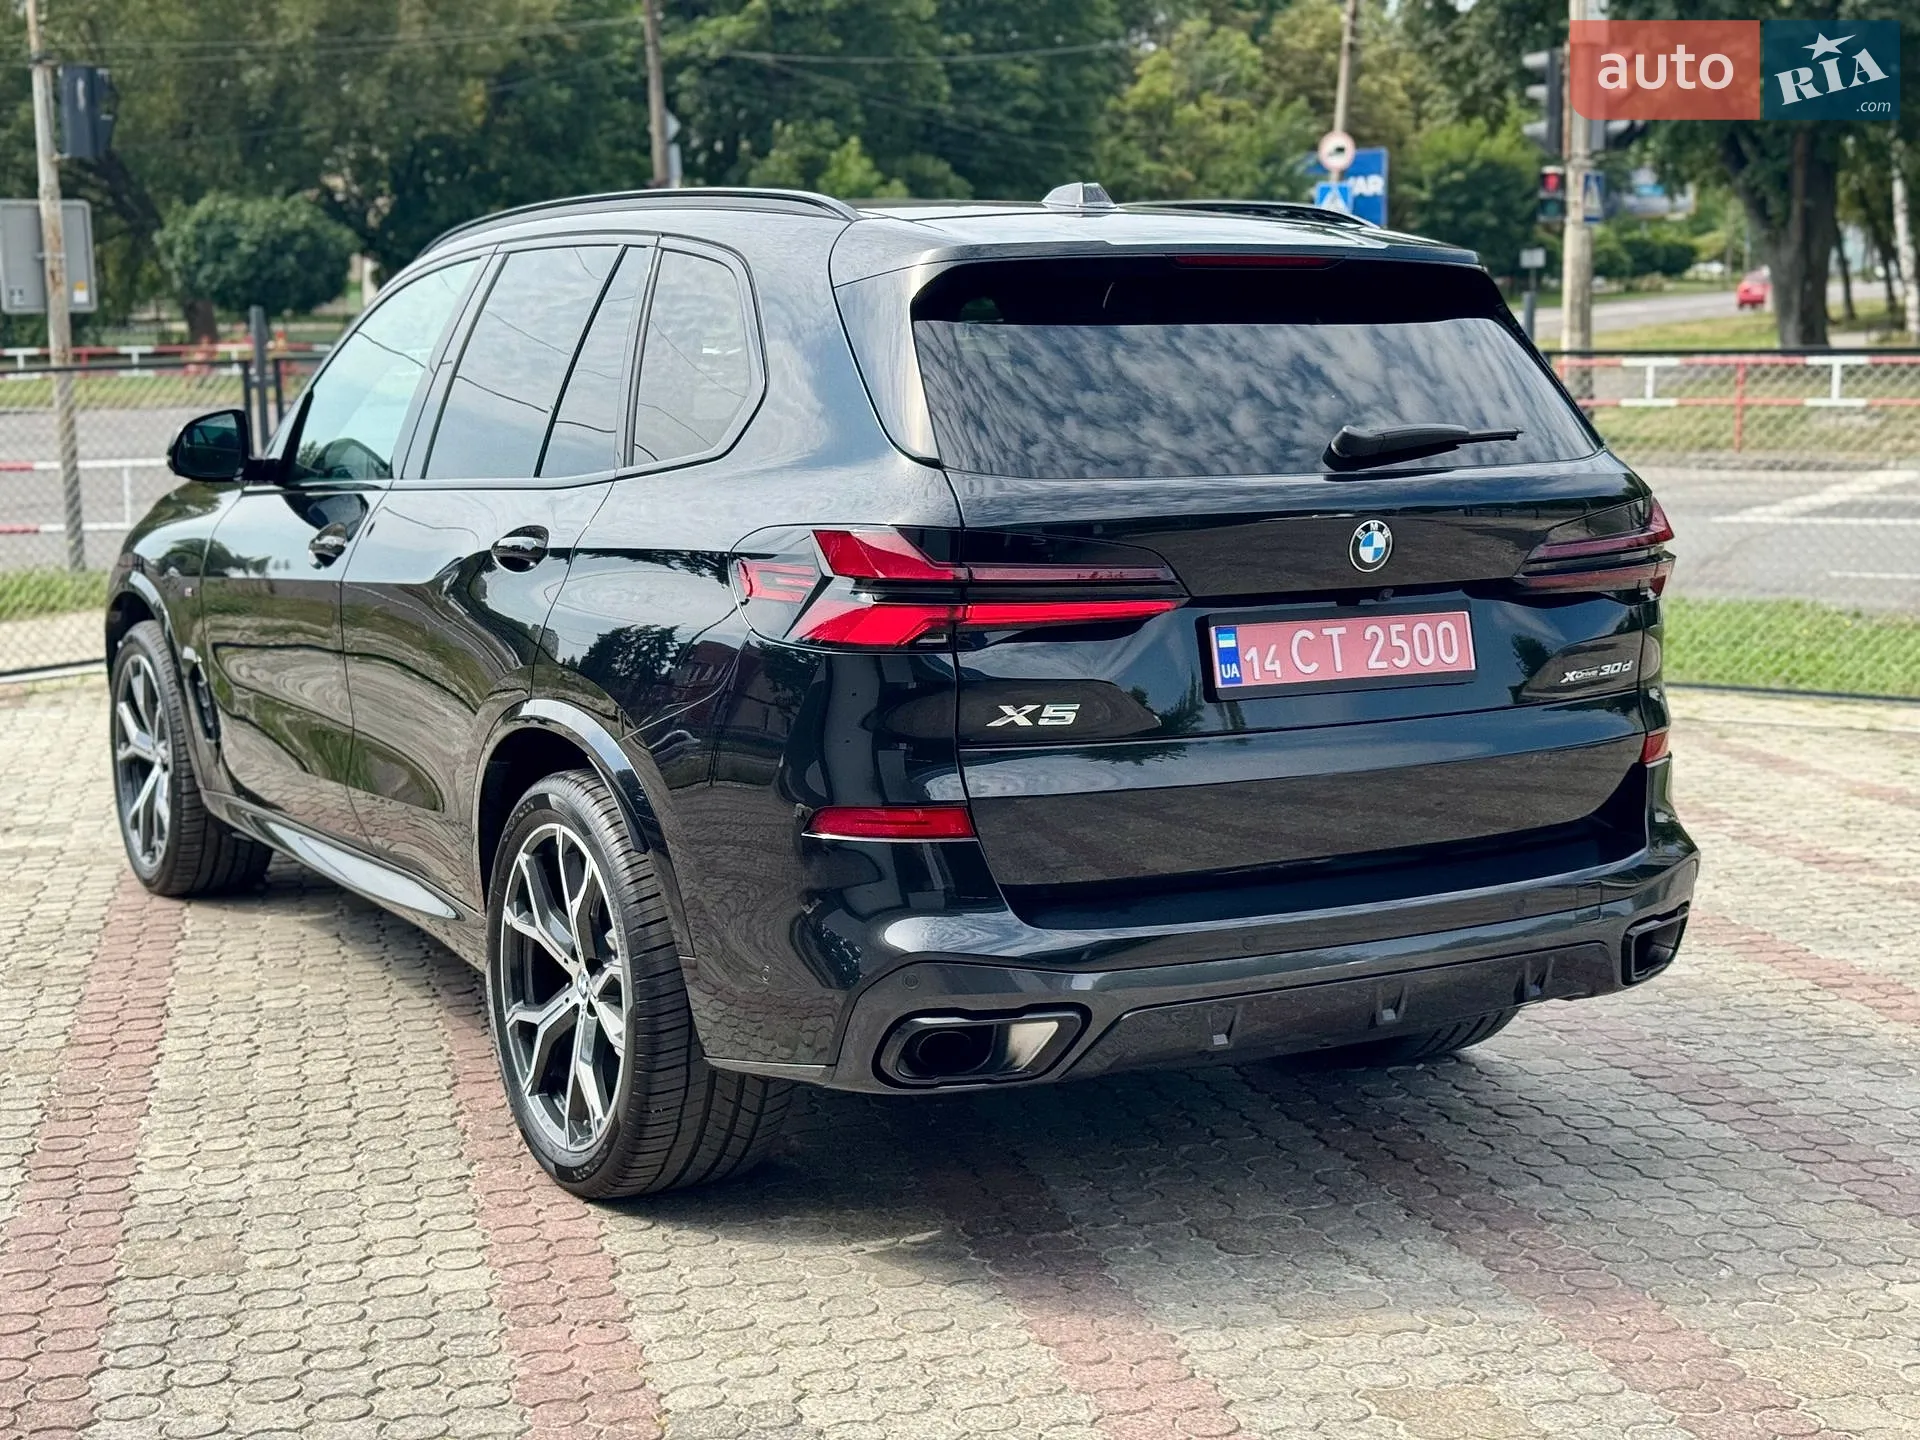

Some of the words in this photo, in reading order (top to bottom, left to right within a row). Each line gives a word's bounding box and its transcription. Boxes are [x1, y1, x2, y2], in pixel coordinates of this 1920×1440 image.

[1244, 646, 1282, 680] 14
[1290, 626, 1347, 674] CT
[1363, 620, 1459, 669] 2500
[1221, 663, 1240, 679] UA
[985, 703, 1081, 727] X5
